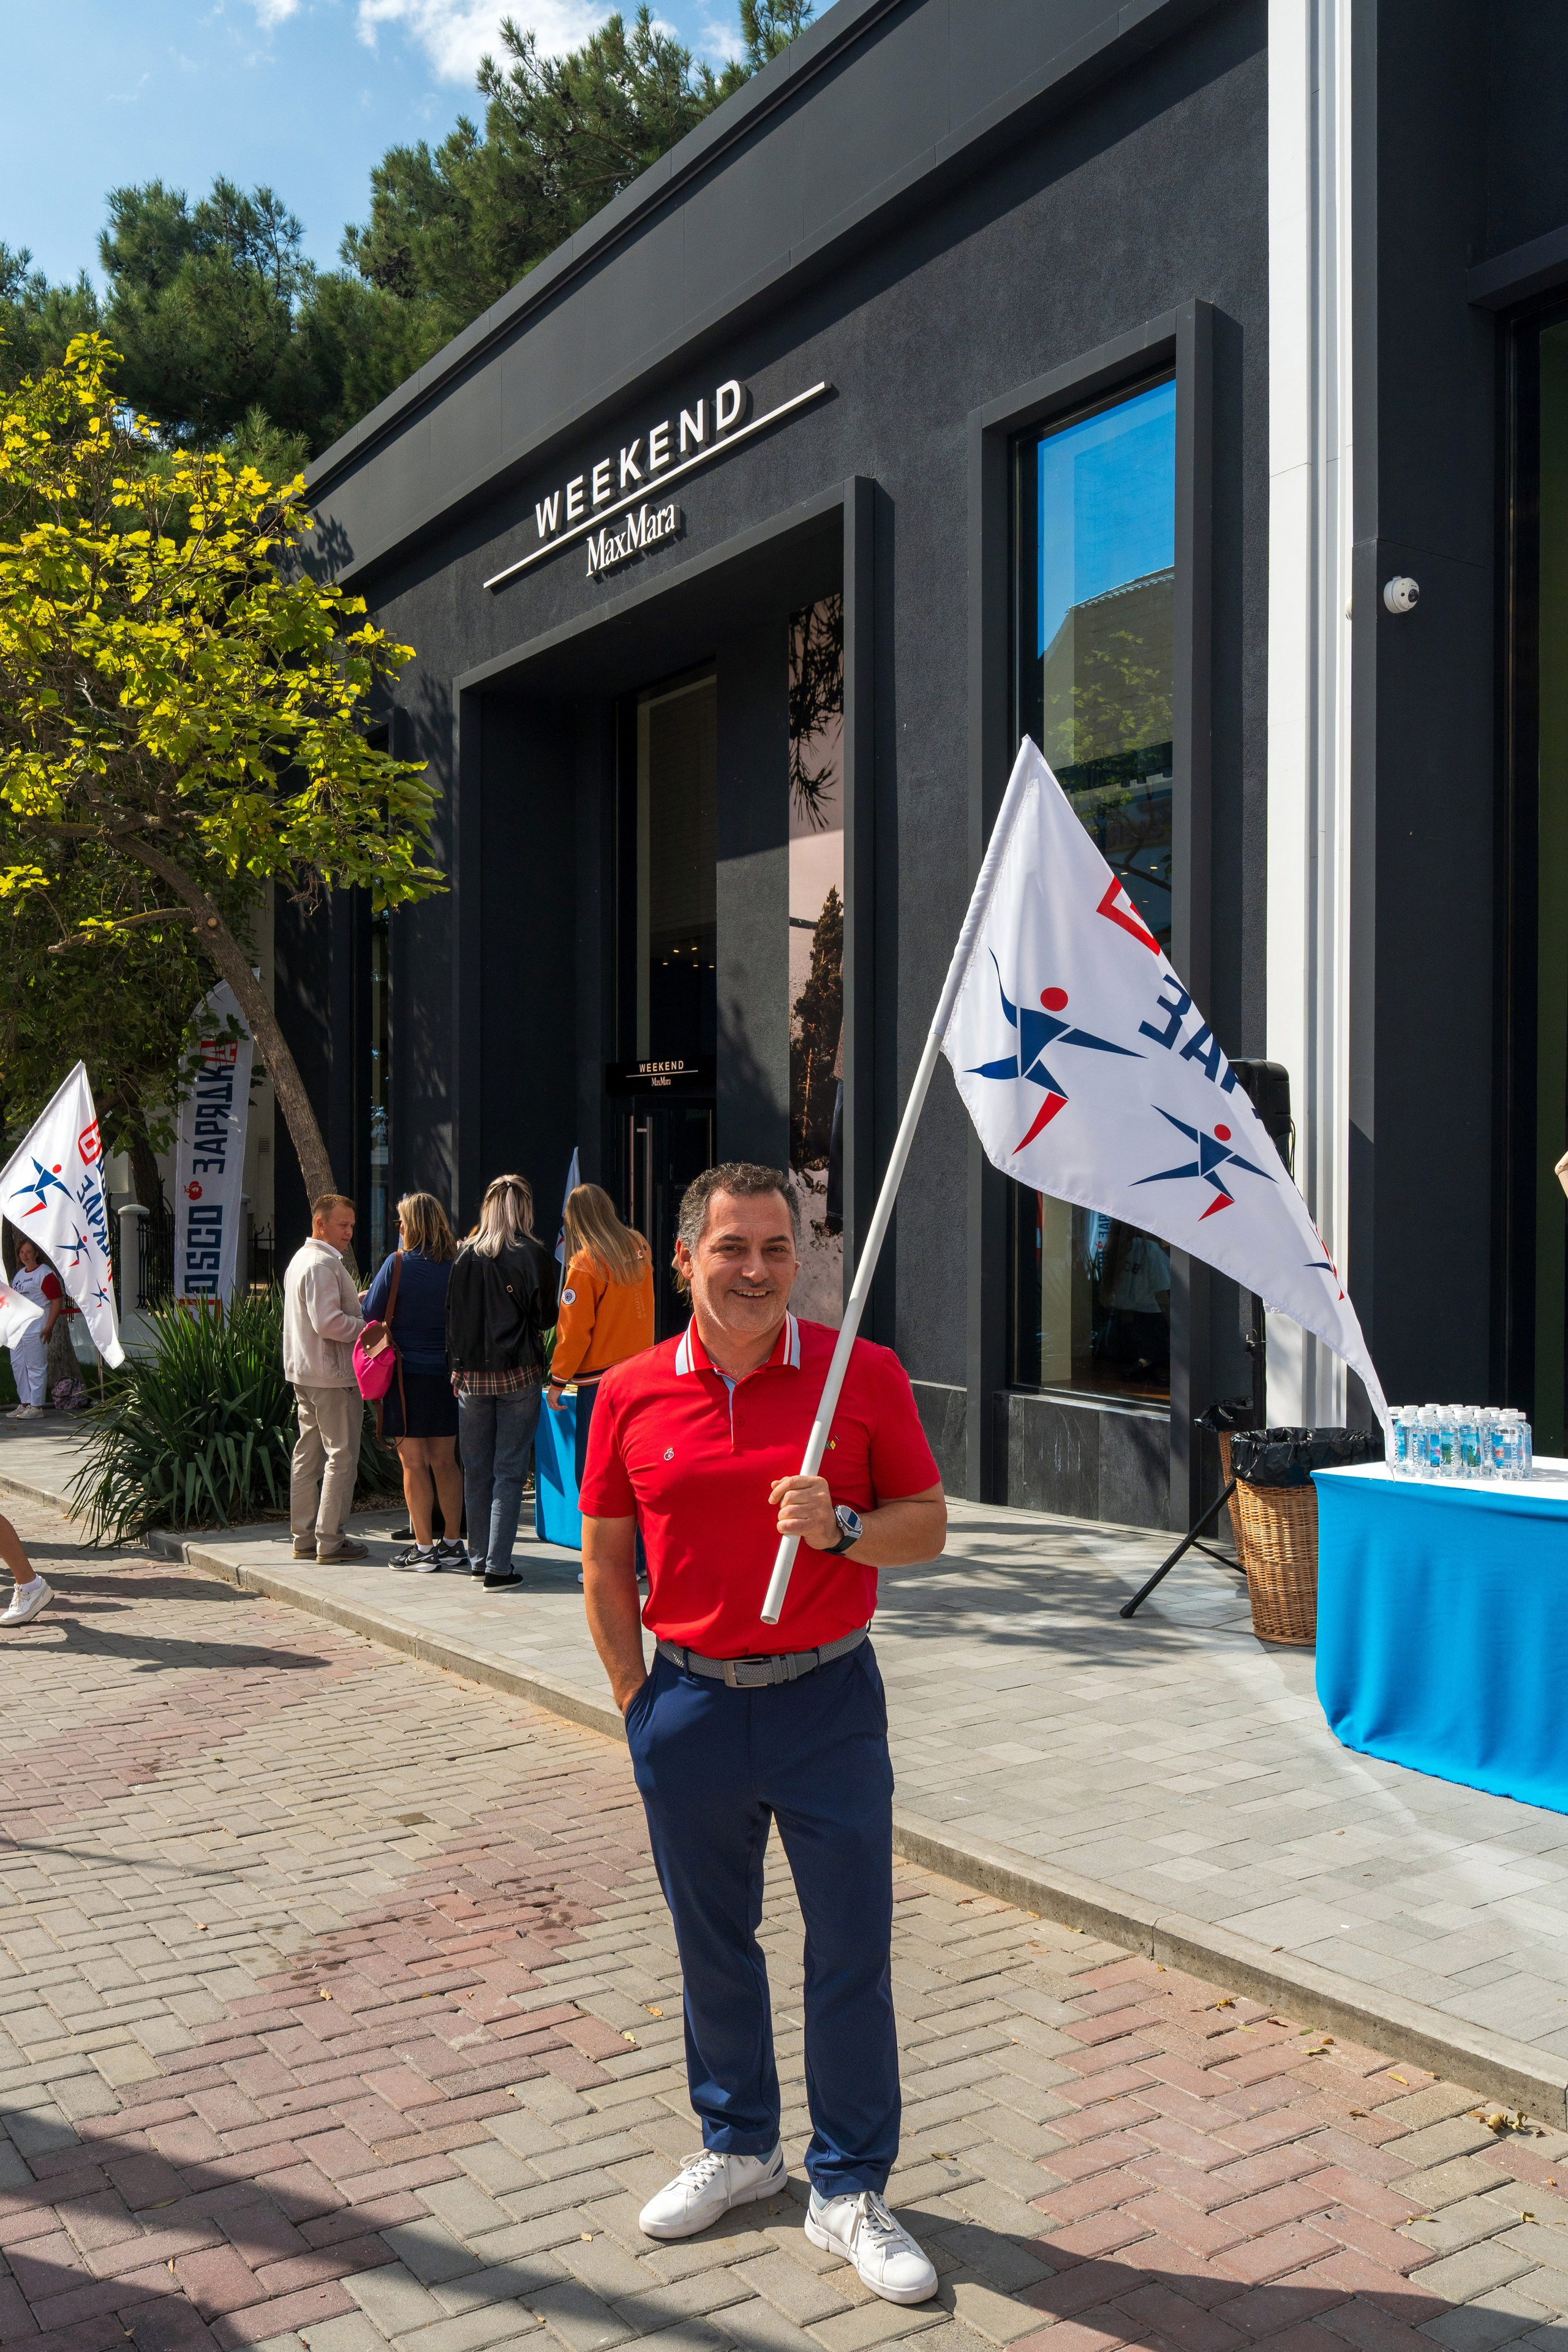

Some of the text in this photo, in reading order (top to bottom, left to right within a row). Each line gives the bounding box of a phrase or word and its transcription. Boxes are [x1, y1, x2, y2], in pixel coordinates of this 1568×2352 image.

[535, 379, 745, 538] WEEKEND
[586, 503, 677, 578] MaxMara
[639, 1060, 684, 1073] WEEKEND
[651, 1076, 671, 1087] MaxMara
[193, 1040, 238, 1175] ЗАРЯДКА
